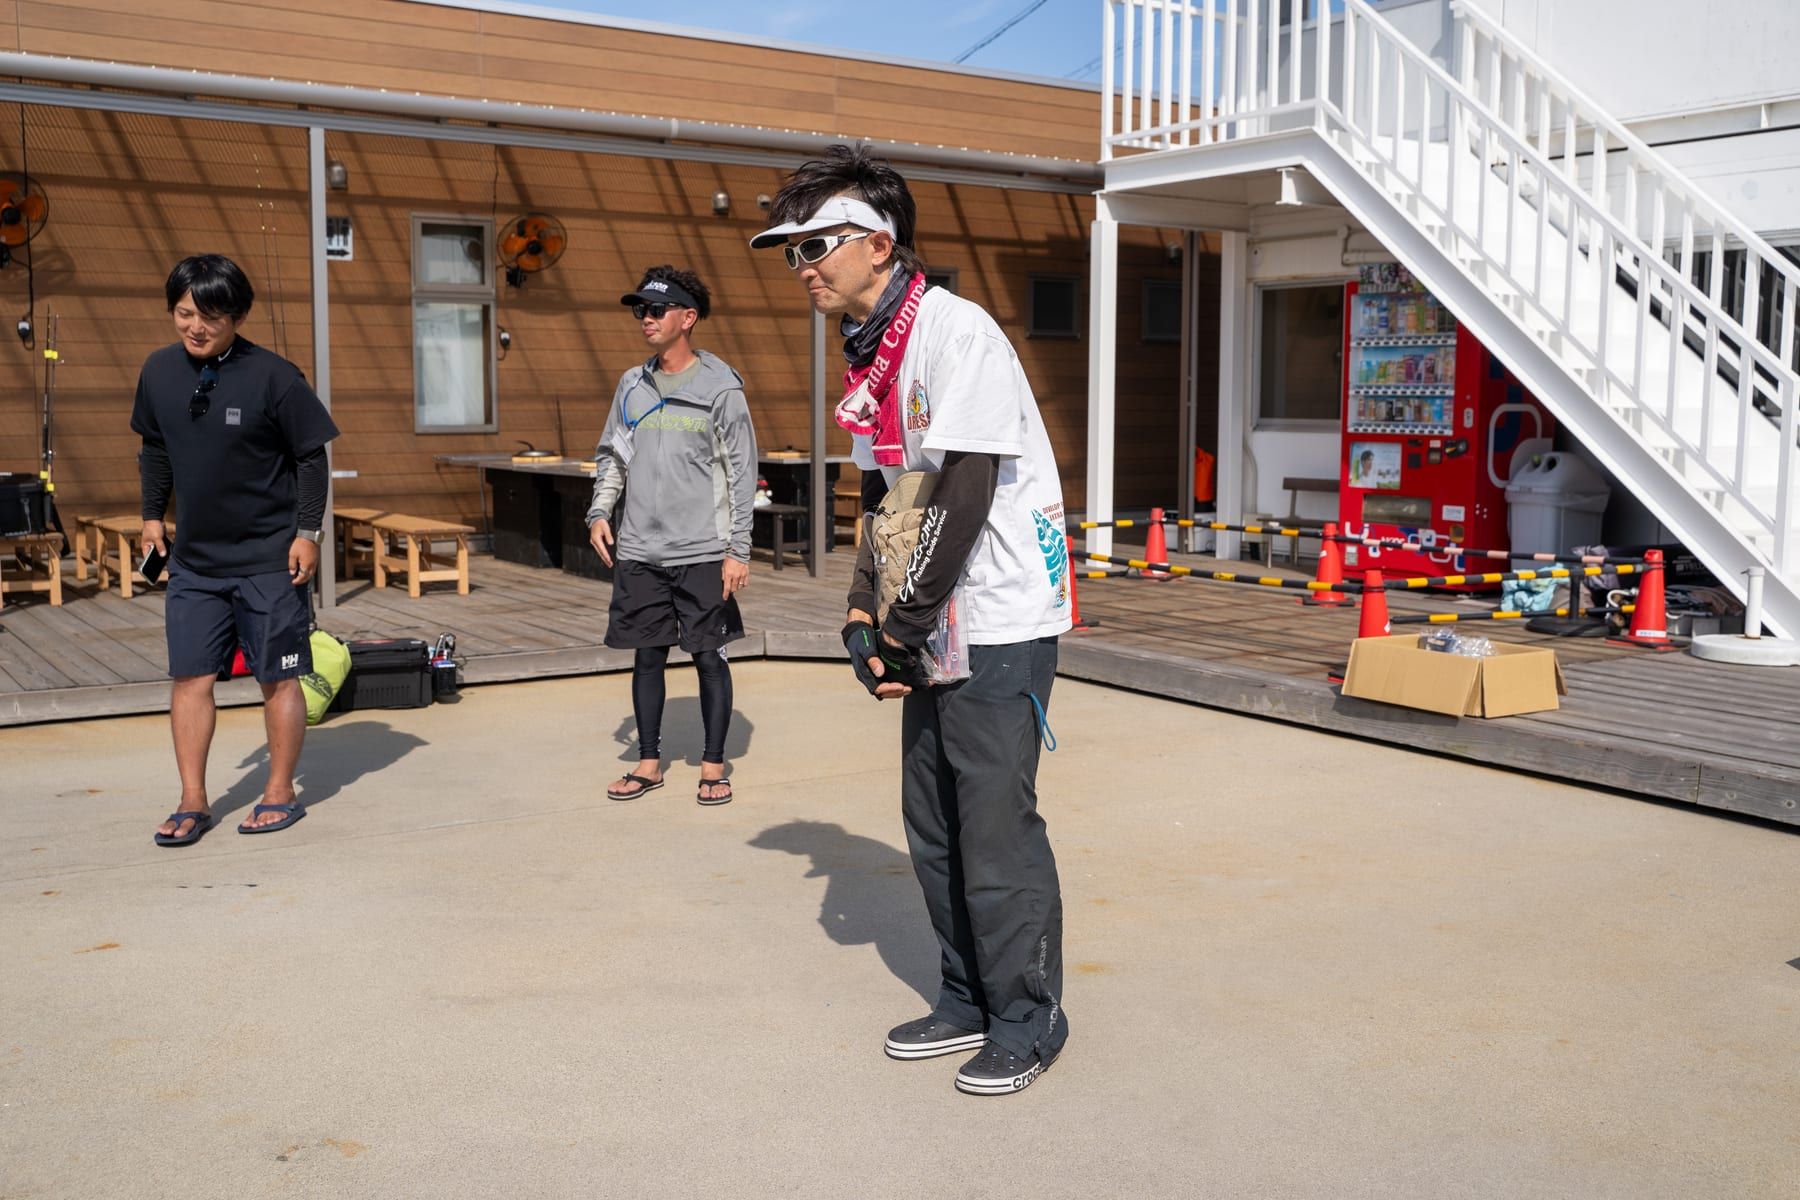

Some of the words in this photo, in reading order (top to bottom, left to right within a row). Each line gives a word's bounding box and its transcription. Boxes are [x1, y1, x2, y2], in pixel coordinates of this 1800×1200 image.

[913, 556, 931, 582] Fishing
[926, 536, 938, 556] Guide
[933, 509, 948, 536] Service
